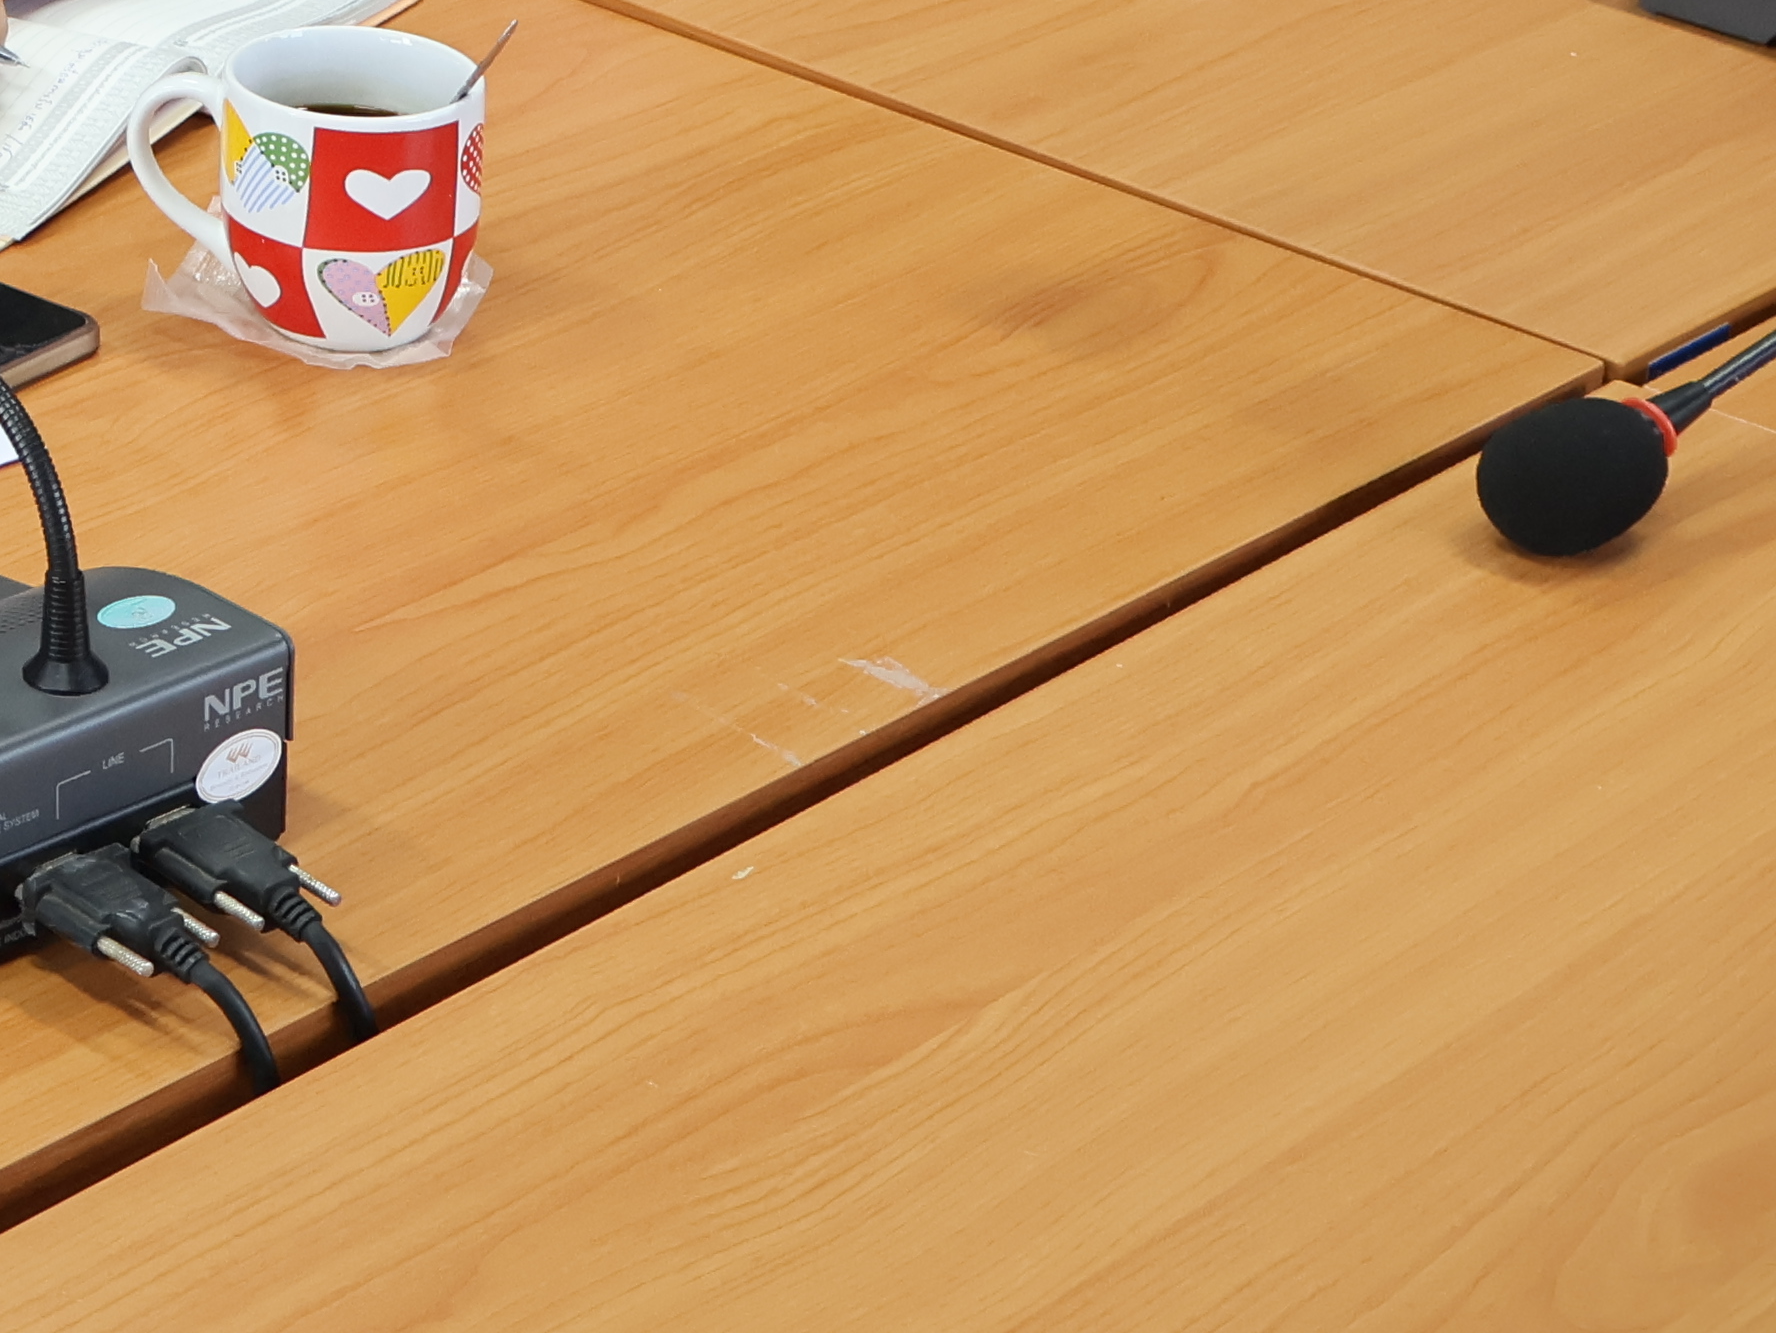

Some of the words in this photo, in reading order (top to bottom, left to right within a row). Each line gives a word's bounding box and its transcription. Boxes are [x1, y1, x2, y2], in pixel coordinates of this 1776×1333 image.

[136, 617, 232, 658] NPE
[204, 667, 284, 721] NPE
[102, 751, 125, 770] LINE
